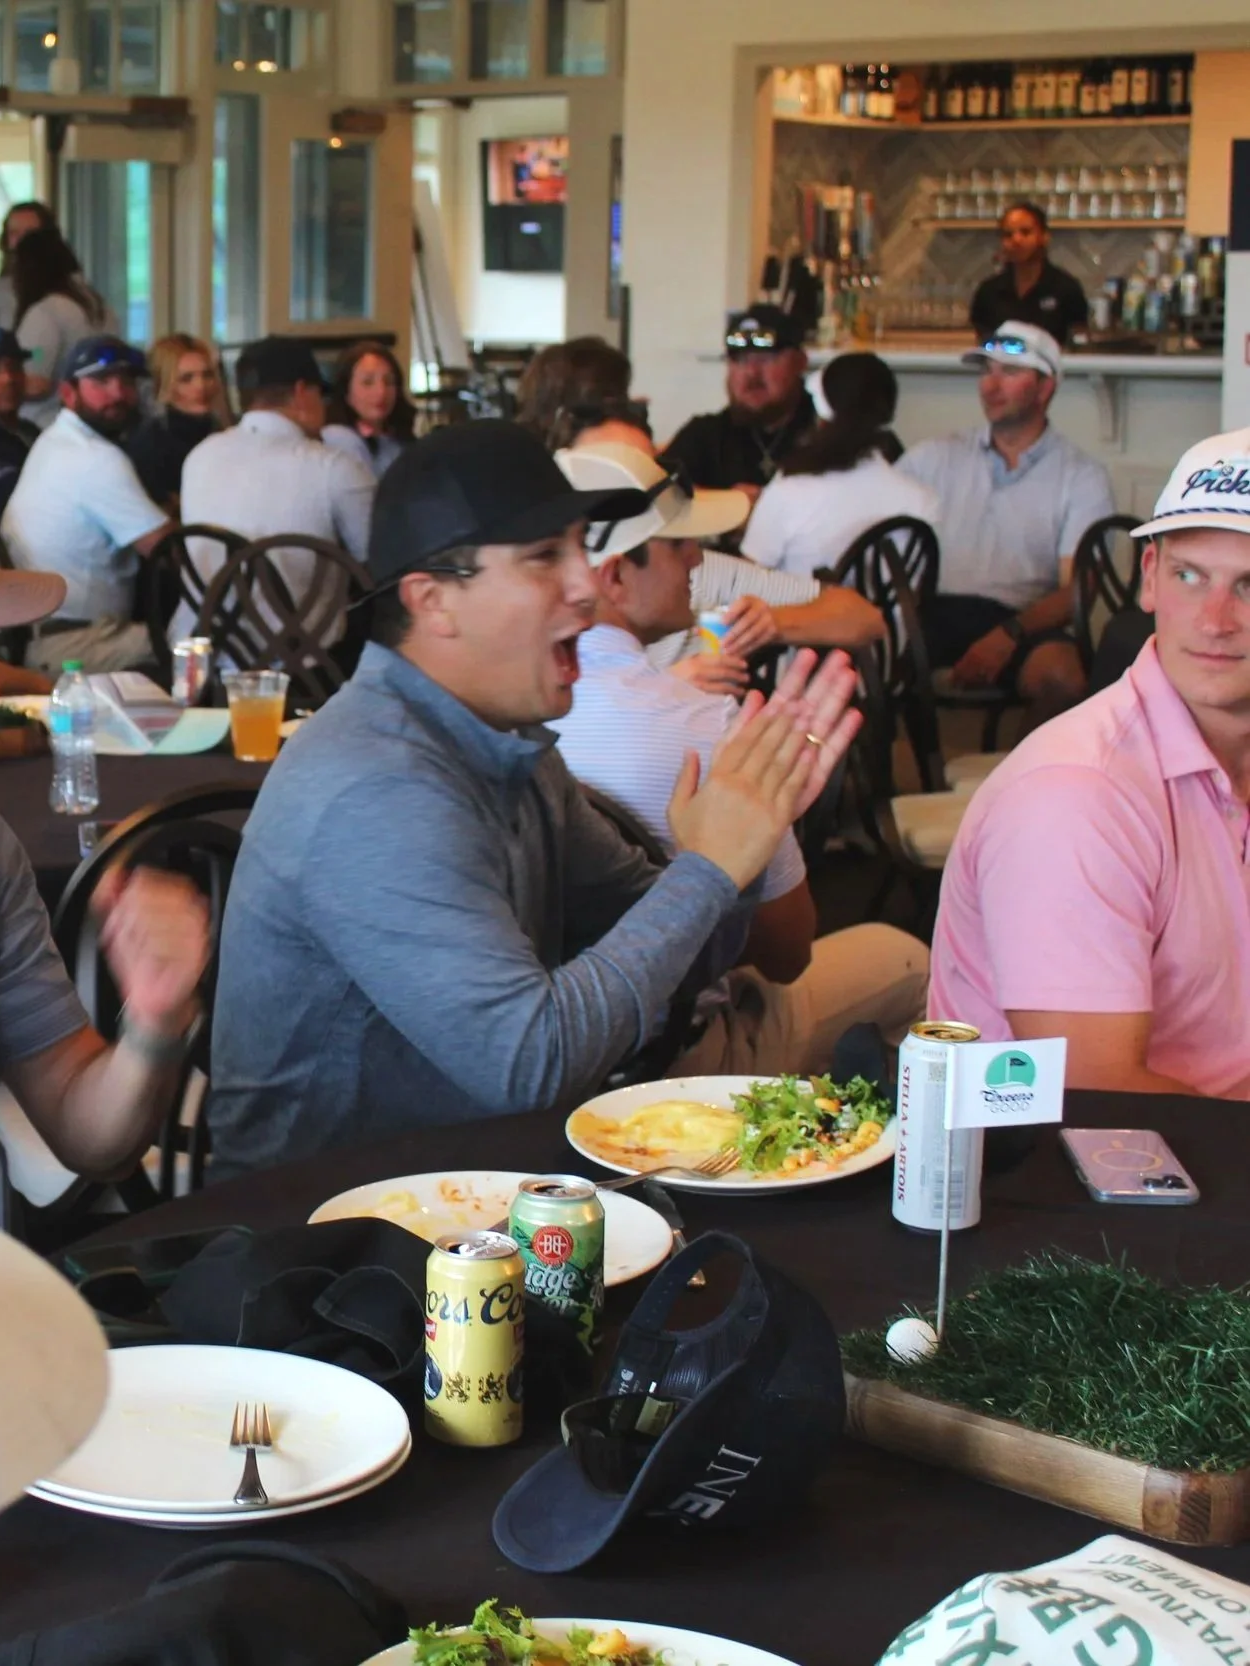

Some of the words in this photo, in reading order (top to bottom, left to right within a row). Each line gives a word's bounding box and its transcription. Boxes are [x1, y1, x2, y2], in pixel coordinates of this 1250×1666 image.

[902, 1065, 910, 1121] STELLA
[898, 1142, 908, 1201] ARTOIS
[525, 1262, 577, 1298] idge
[1088, 1553, 1250, 1632] OPMENT
